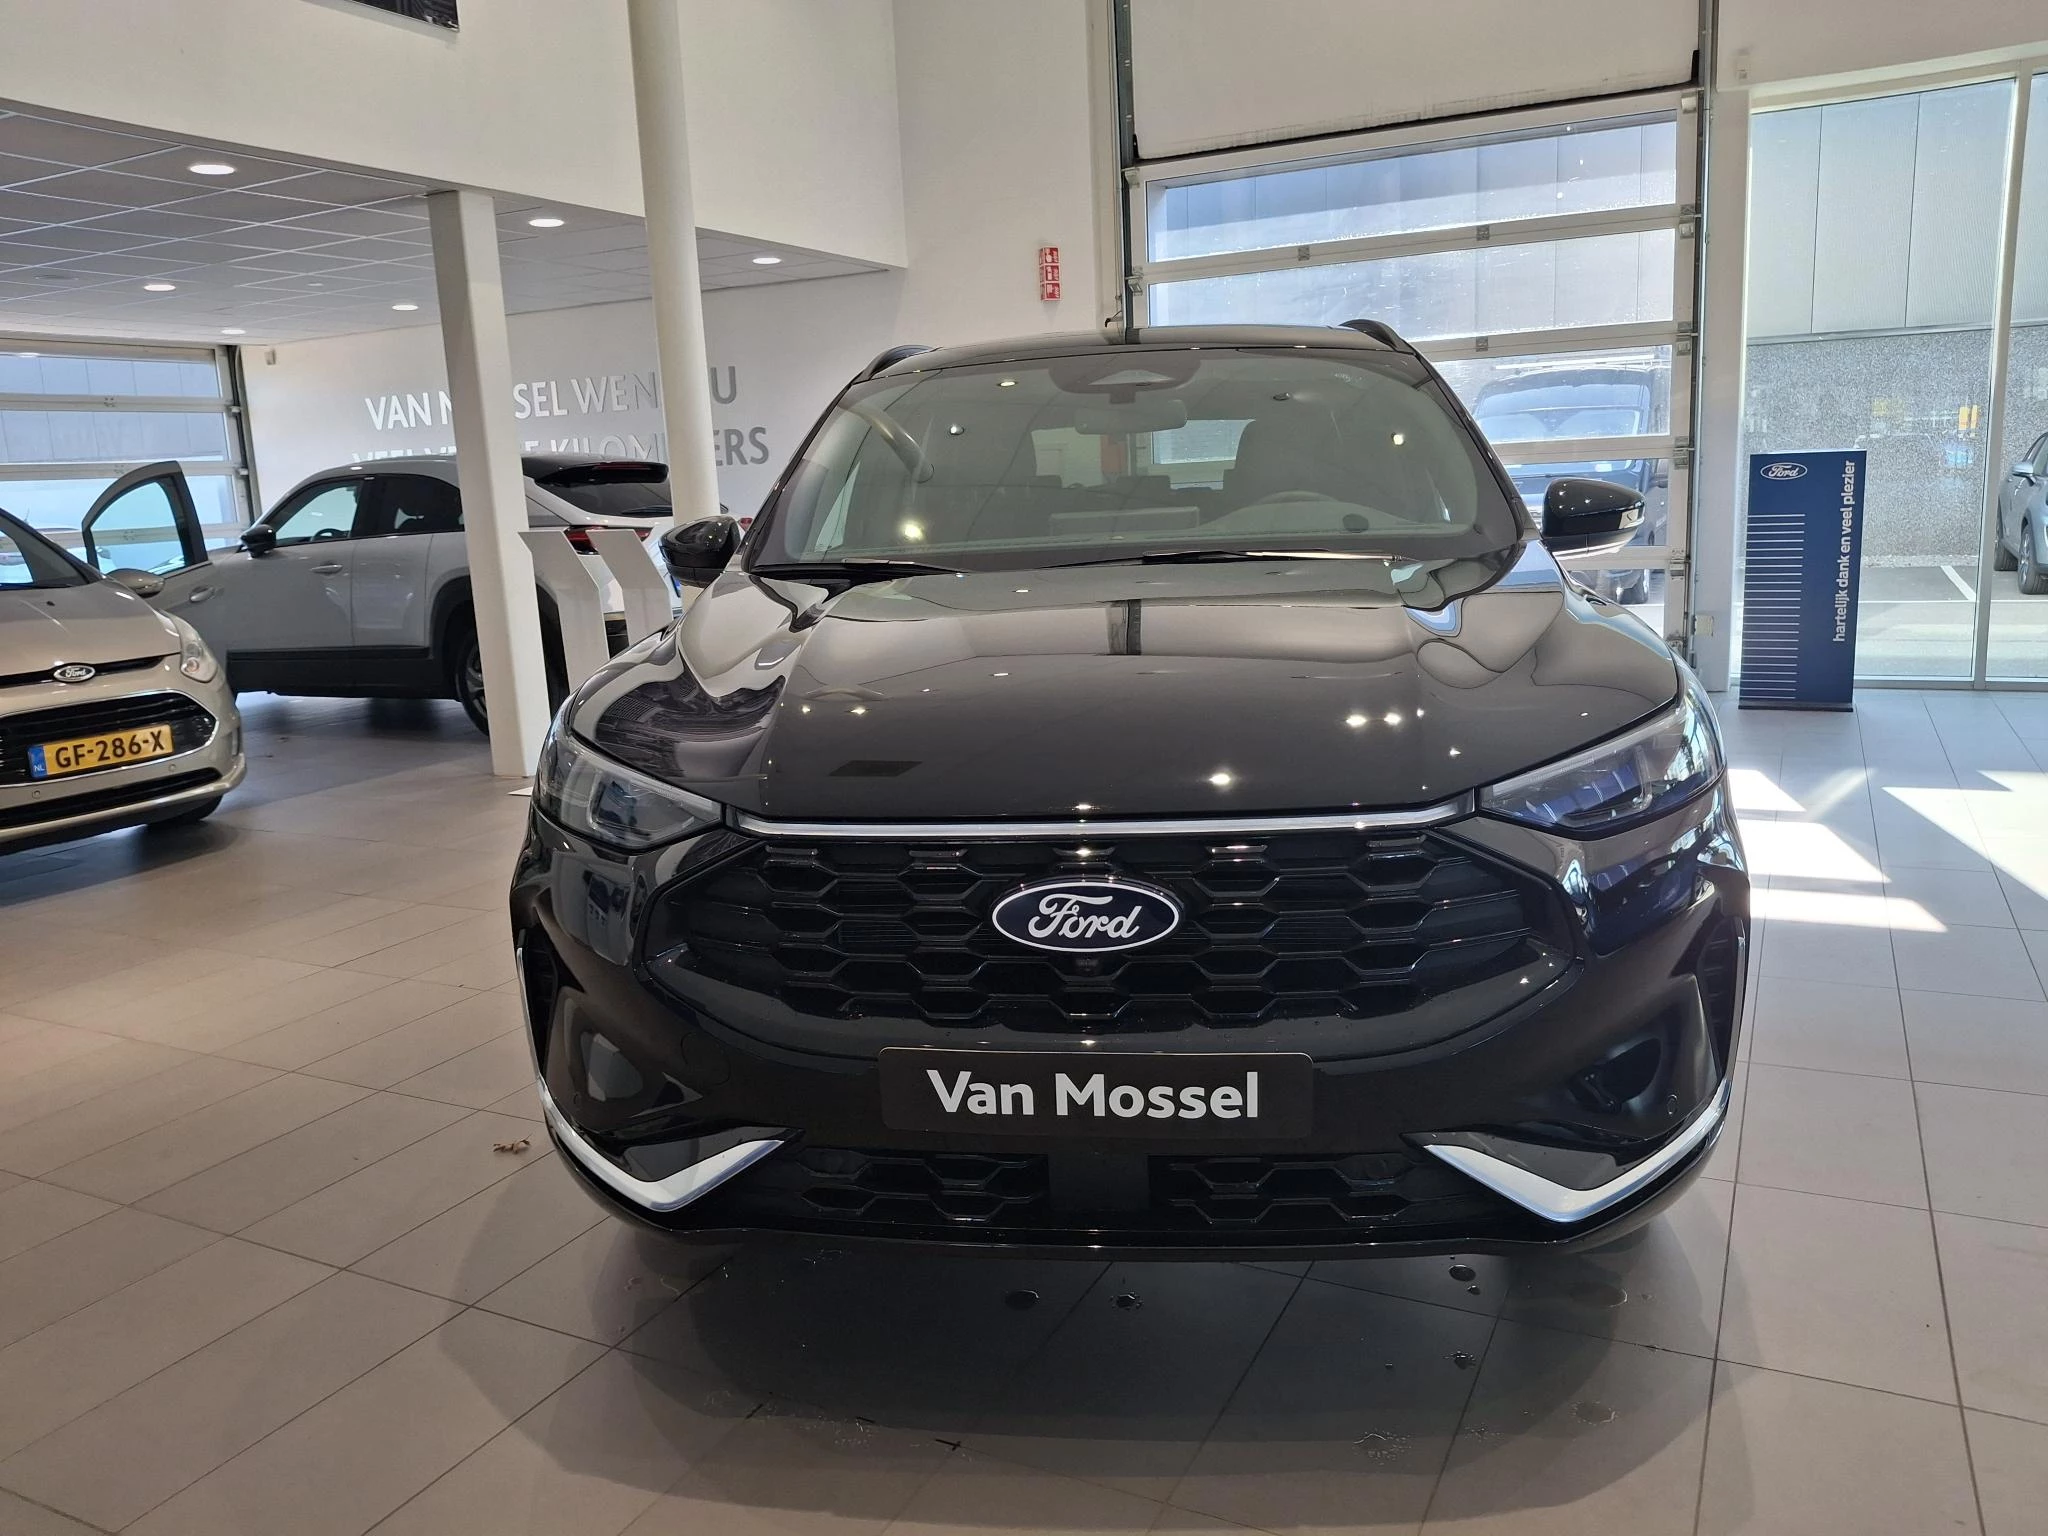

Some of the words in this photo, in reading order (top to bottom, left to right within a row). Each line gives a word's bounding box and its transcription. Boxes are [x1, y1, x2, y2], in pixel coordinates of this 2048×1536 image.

[364, 392, 432, 431] VAN
[438, 378, 568, 424] SEL
[570, 371, 658, 414] WEN
[710, 365, 737, 405] U
[1768, 464, 1799, 477] Ford
[1840, 460, 1856, 505] plezier
[1839, 507, 1853, 535] veel
[1840, 536, 1851, 553] en
[1836, 555, 1850, 588] dank
[1832, 589, 1850, 642] hartelijk
[65, 667, 87, 678] Ford
[55, 730, 165, 769] GF-286-X
[34, 764, 45, 772] NL
[1028, 893, 1142, 939] Ford
[926, 1069, 1035, 1117] Van
[1055, 1071, 1259, 1119] Mossel
